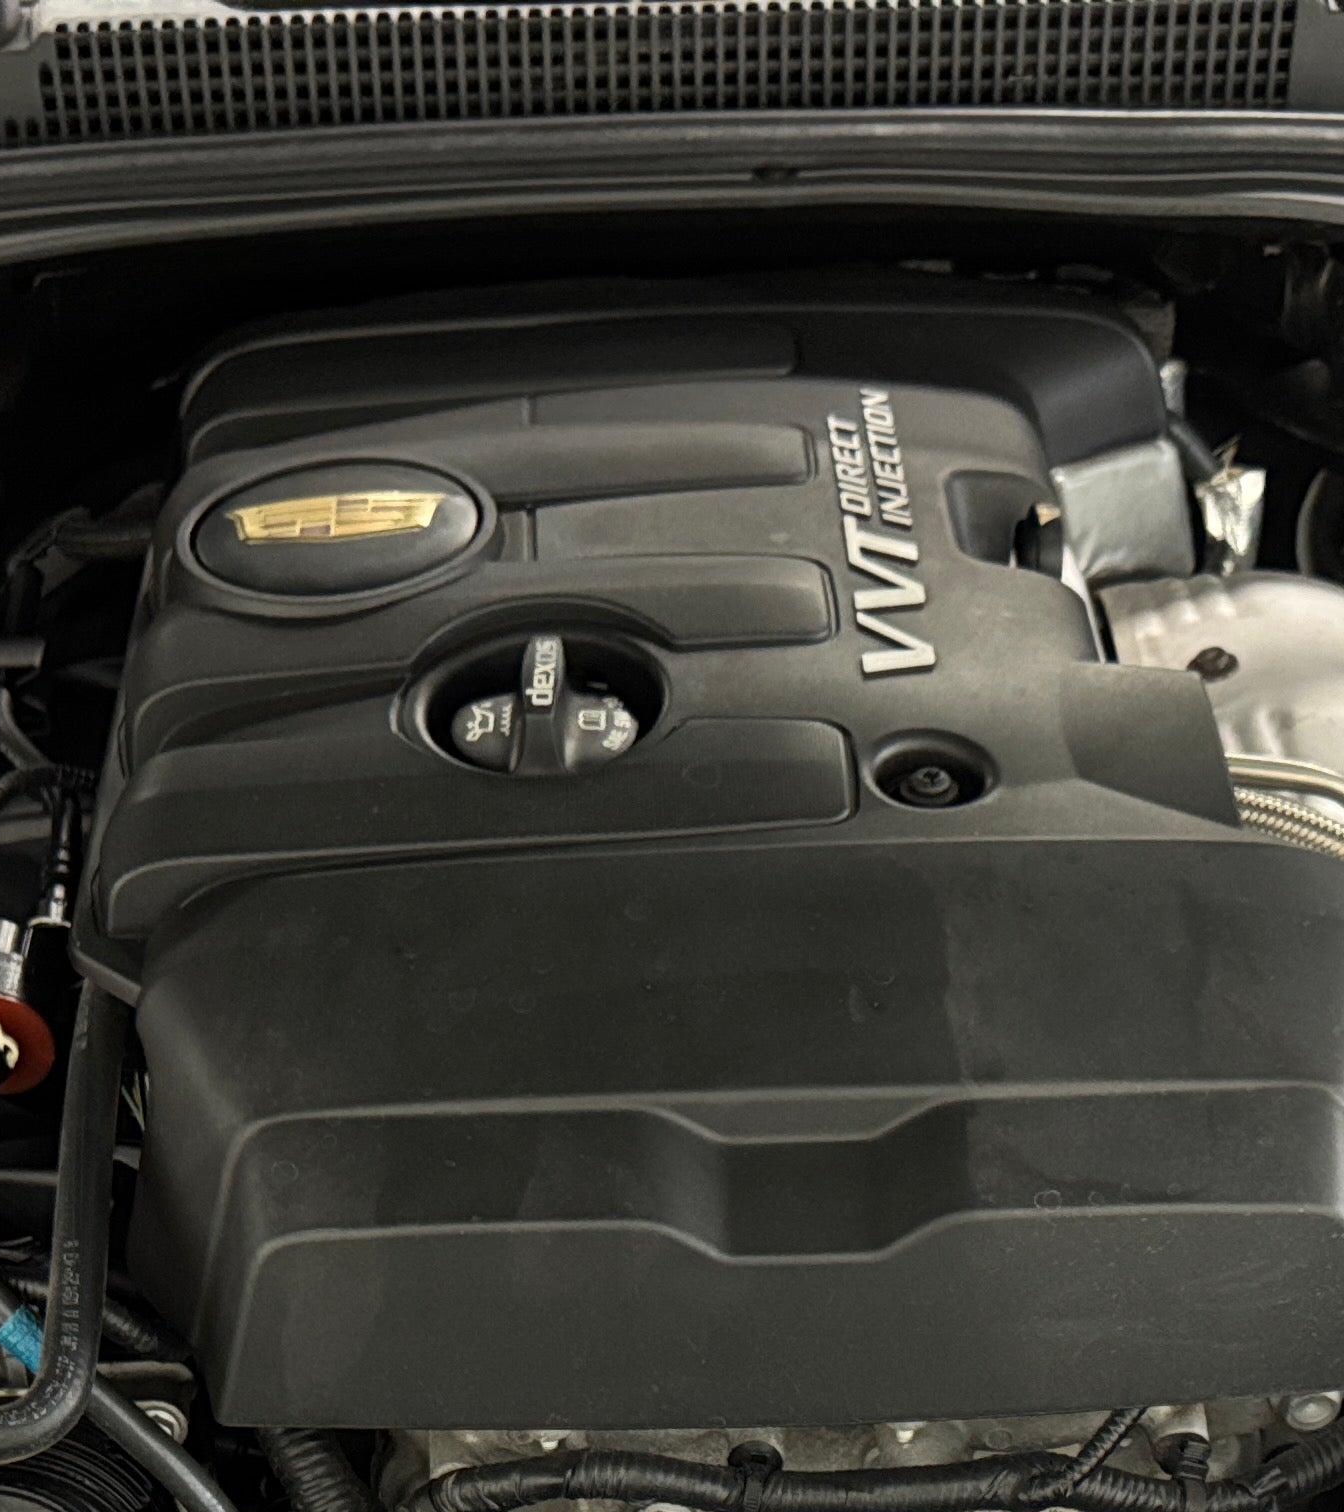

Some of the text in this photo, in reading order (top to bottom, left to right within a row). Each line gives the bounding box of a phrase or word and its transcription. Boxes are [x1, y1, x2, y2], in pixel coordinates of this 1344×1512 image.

[826, 413, 873, 518] DIRECT
[859, 387, 913, 527] INJECTION
[843, 514, 936, 674] VVT
[525, 637, 558, 706] dexos
